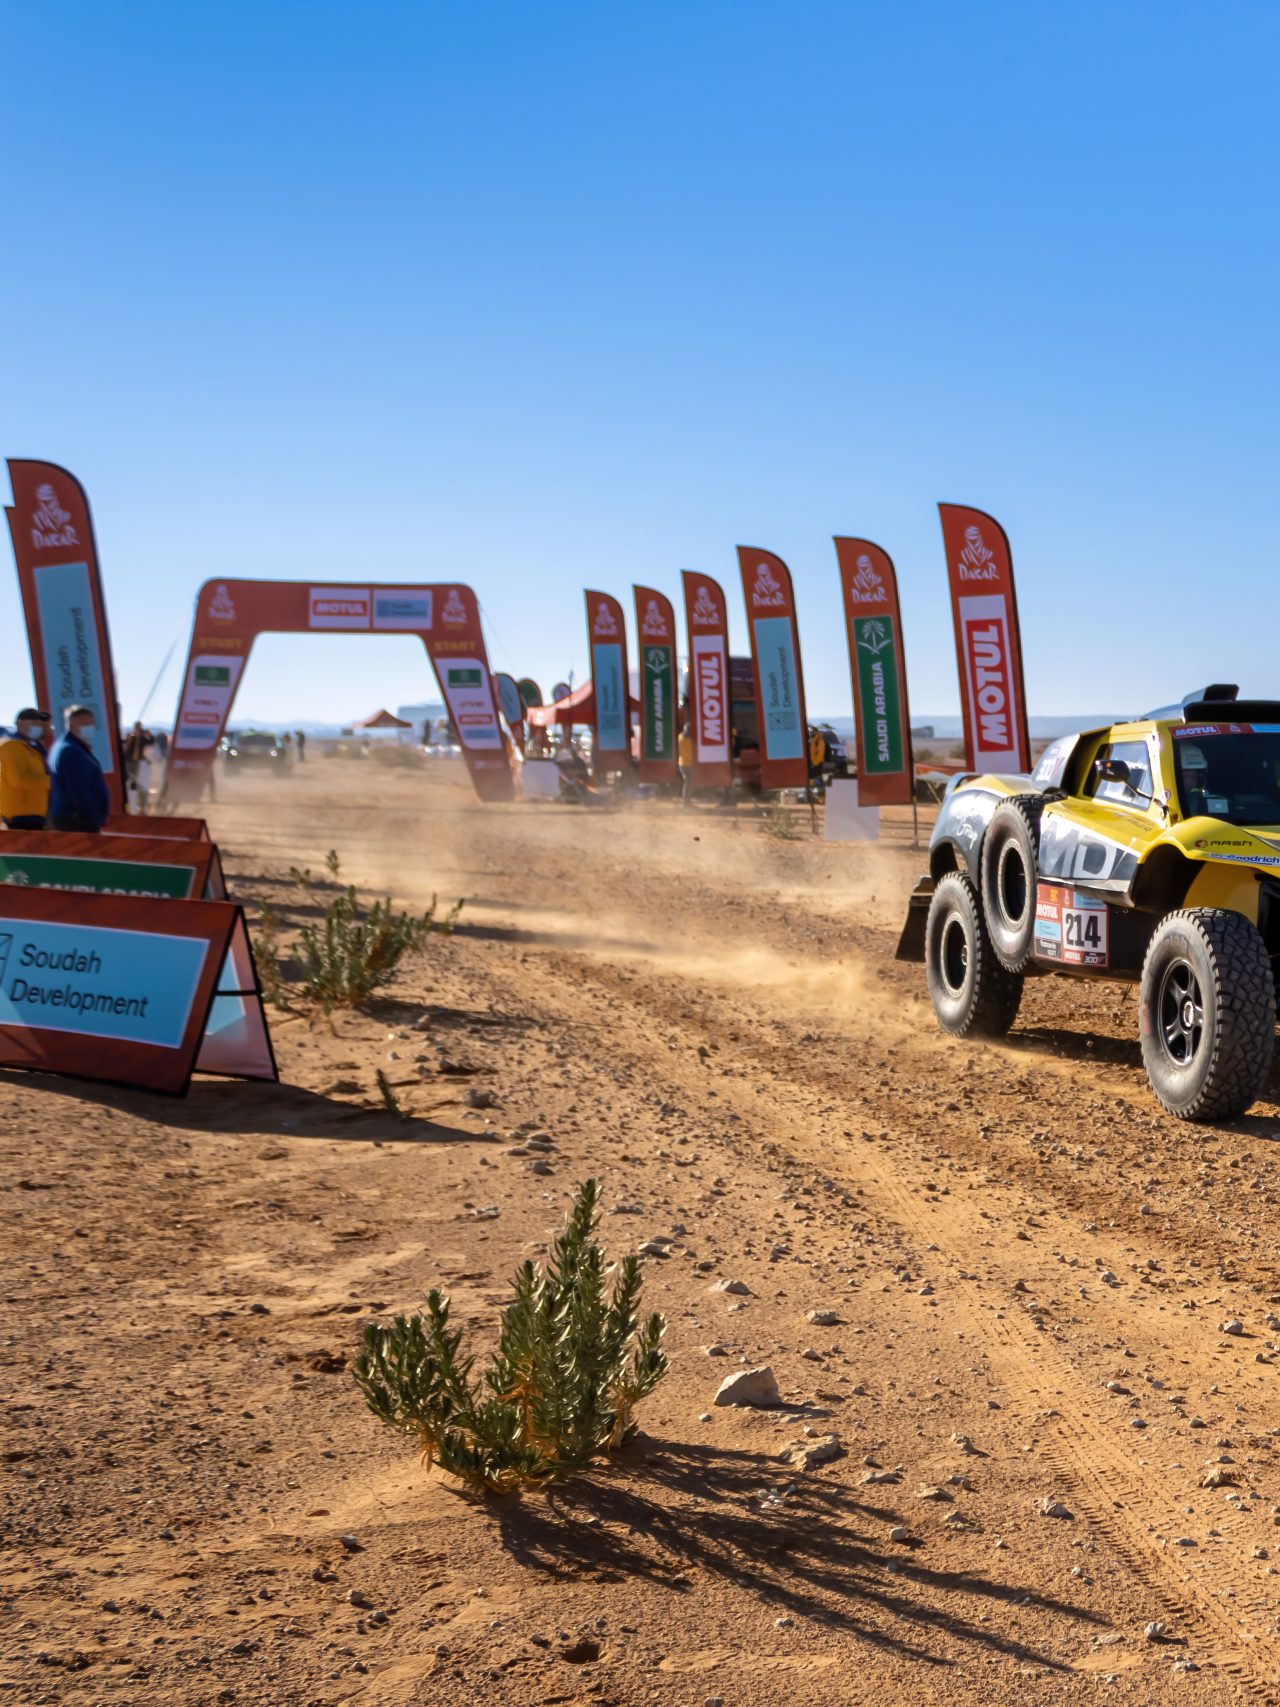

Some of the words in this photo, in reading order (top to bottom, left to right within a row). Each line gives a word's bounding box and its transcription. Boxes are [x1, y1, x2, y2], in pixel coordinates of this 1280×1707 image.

[31, 529, 80, 549] DAKAR
[957, 562, 1000, 581] DAKAR
[316, 602, 364, 614] MOTUL
[852, 587, 888, 604] DAKAR
[70, 607, 92, 698] Development
[57, 644, 73, 698] Soudah
[872, 661, 887, 716] ARABIA
[973, 624, 1007, 746] MOTUL
[701, 656, 722, 742] MOTUL
[876, 719, 890, 762] SAUDI
[1175, 726, 1217, 737] MOTUL
[1036, 904, 1058, 919] MOTUL
[1066, 913, 1101, 948] 214
[19, 943, 102, 976] Soudah
[10, 979, 149, 1018] Development
